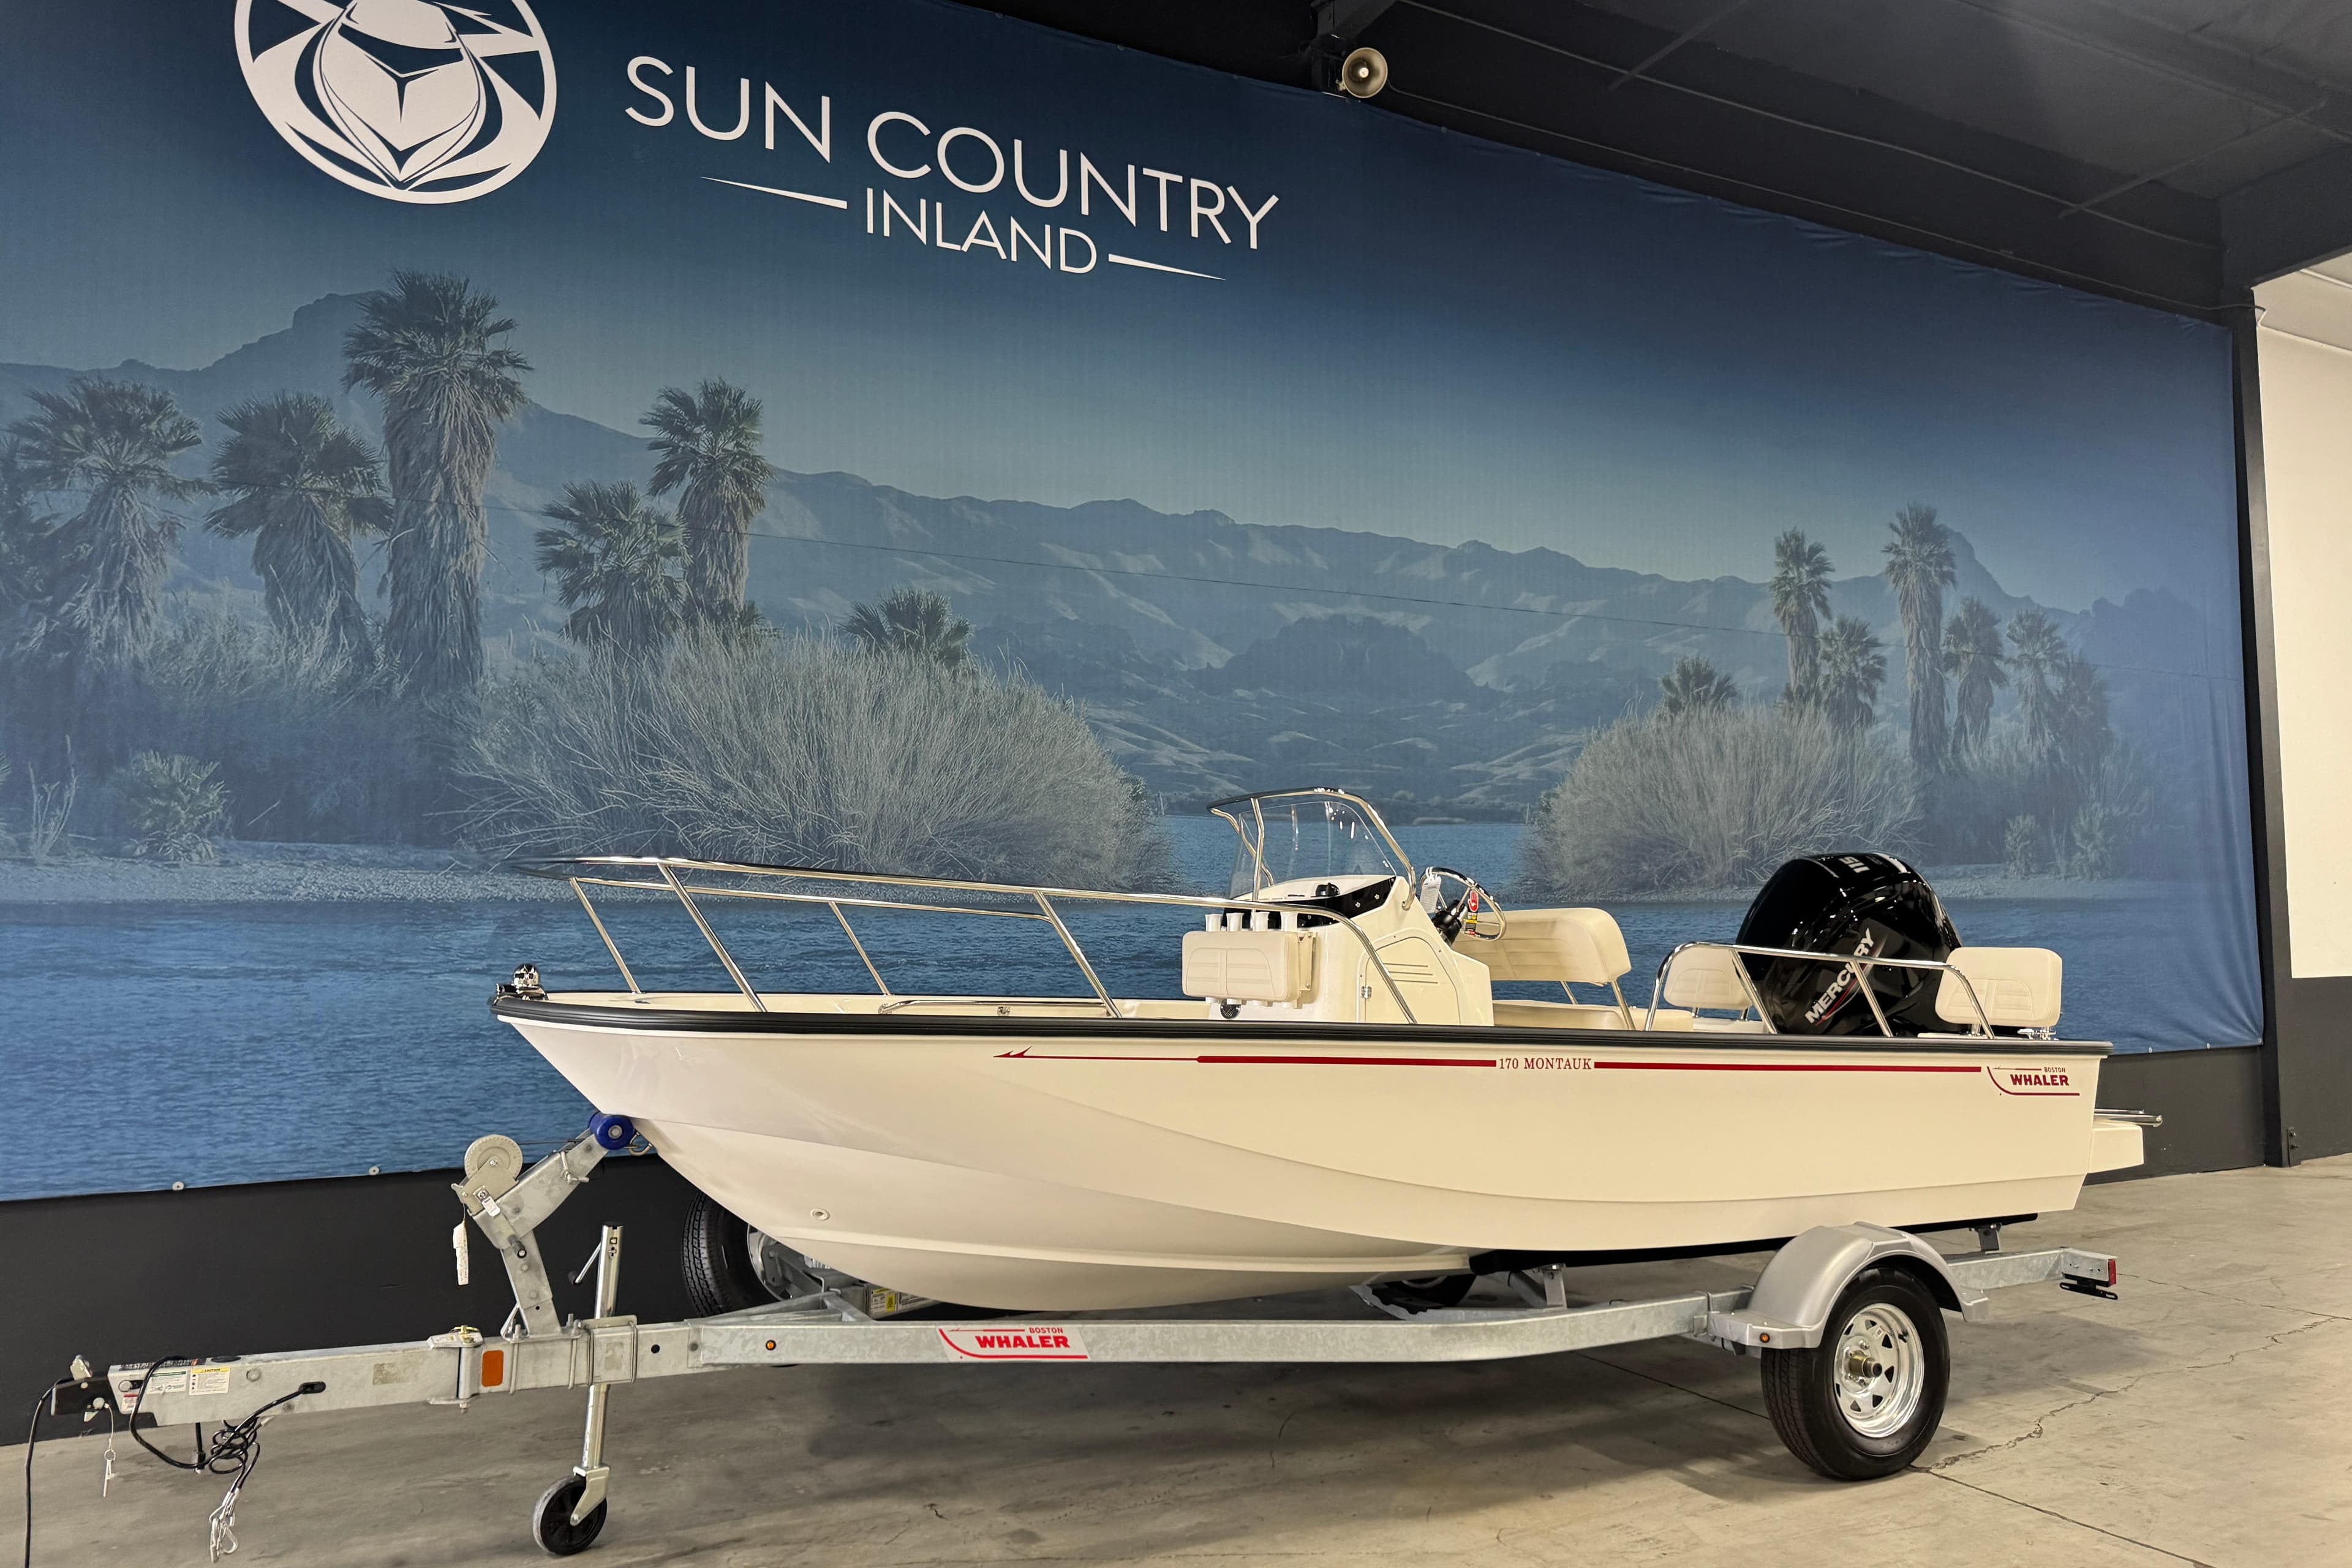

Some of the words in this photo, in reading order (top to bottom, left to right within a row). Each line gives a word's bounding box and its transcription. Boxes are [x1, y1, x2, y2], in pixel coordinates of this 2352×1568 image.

[625, 56, 830, 163] SUN
[867, 111, 1279, 249] COUNTRY
[867, 187, 1097, 274] INLAND
[1838, 856, 1870, 873] 115
[1499, 1058, 1519, 1069] 170
[1523, 1057, 1592, 1069] MONTAUK
[2010, 1074, 2070, 1086] WHALER
[974, 1335, 1071, 1348] WHALER
